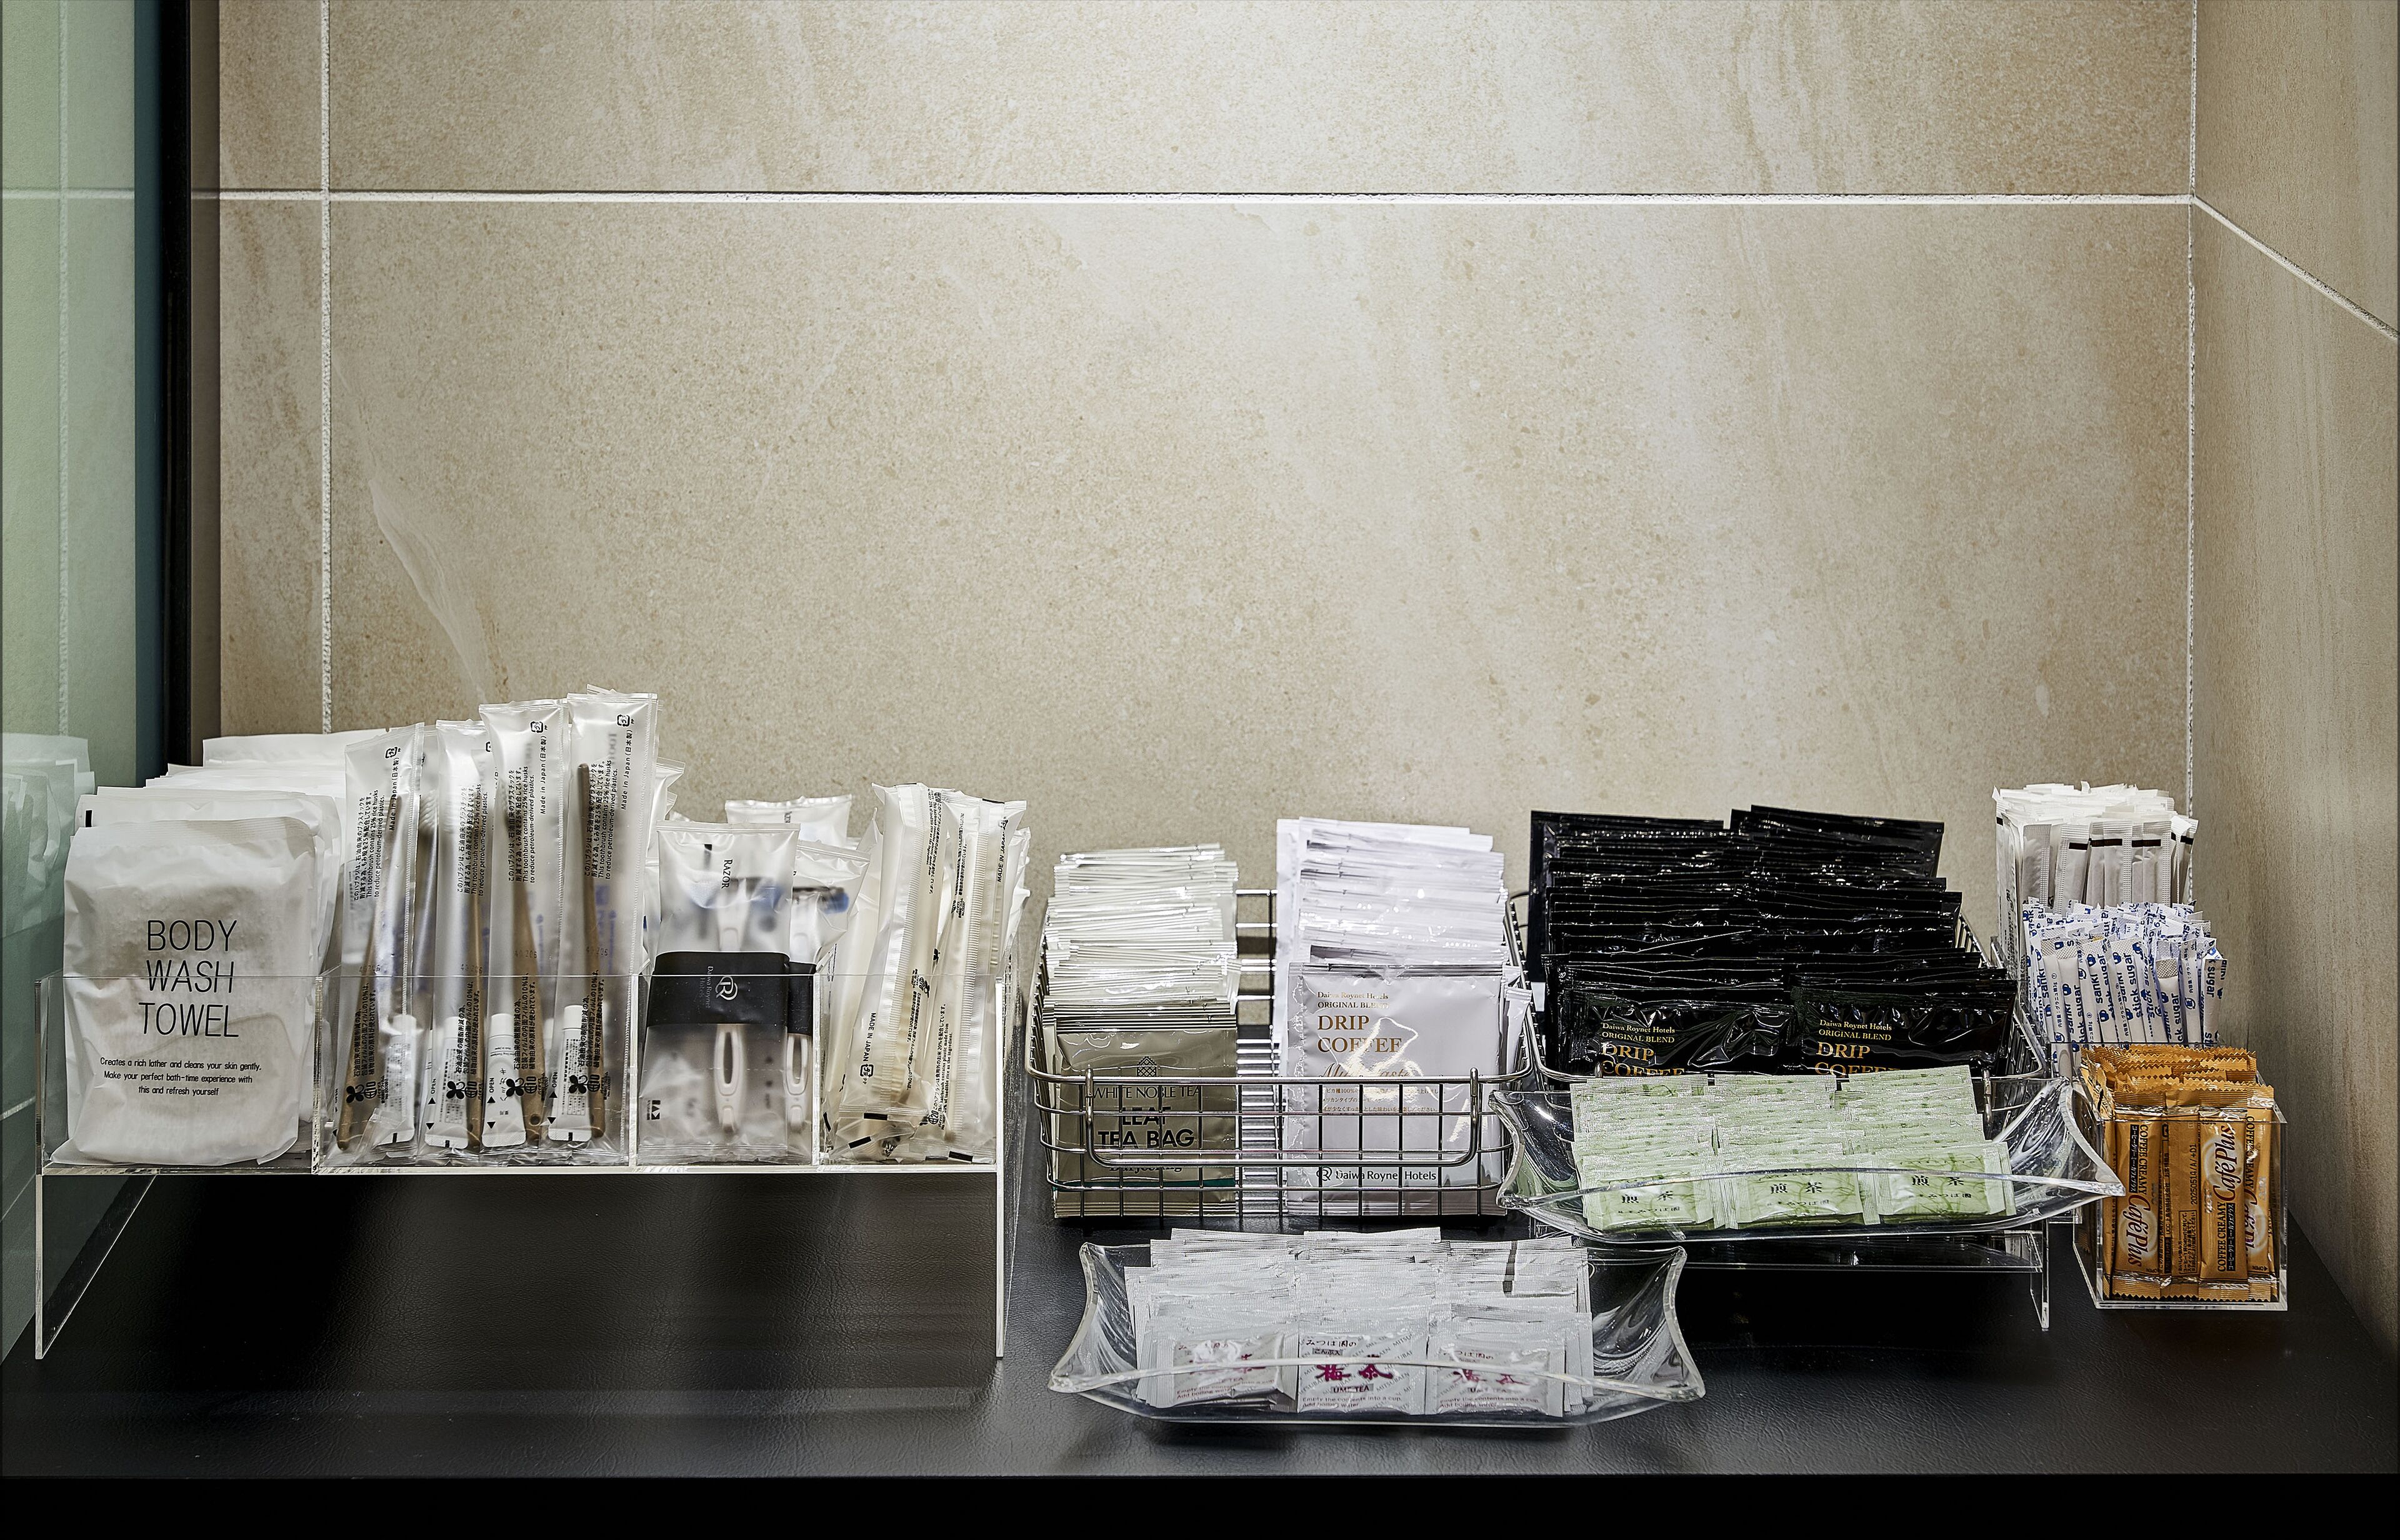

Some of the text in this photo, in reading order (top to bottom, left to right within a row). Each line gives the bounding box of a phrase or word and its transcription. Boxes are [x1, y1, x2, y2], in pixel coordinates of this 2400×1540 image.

[600, 805, 608, 830] contains
[599, 831, 607, 864] toothbrush
[721, 859, 733, 889] RAZOR
[147, 920, 237, 952] BODY
[146, 959, 234, 994] WASH
[2038, 968, 2049, 998] sanki
[2123, 952, 2144, 1019] stick sugar
[2206, 966, 2216, 998] sugar
[2090, 974, 2103, 1004] sanki
[2074, 985, 2088, 1046] tick sugar
[2171, 992, 2181, 1025] sugar
[138, 1002, 239, 1038] TOWEL
[868, 1012, 876, 1031] MADE
[1318, 1015, 1369, 1030] DRIP
[1626, 1025, 1651, 1033] Roynet
[1844, 1022, 1868, 1030] Roynet
[1602, 1032, 1644, 1041] ORIGINAL
[1819, 1029, 1861, 1038] ORIGINAL
[862, 1041, 871, 1061] JAPAN
[1601, 1042, 1654, 1061] DRIP
[1816, 1041, 1870, 1058] DRIP
[100, 1058, 125, 1066] Creates
[149, 1059, 167, 1068] lather
[240, 1062, 261, 1071] gently.
[1815, 1062, 1900, 1078] COFF
[201, 1076, 235, 1084] experience
[192, 1088, 219, 1096] yourself
[1136, 1086, 1176, 1098] NOBLE
[1179, 1086, 1200, 1097] TEA
[1122, 1106, 1171, 1125] LEAF
[1098, 1129, 1194, 1149] TEA BAG
[2138, 1125, 2148, 1195] COFFEE CREAMY
[1368, 1171, 1399, 1182] Royne
[1405, 1171, 1436, 1180] Hotels
[2218, 1201, 2226, 1239] CREAMY
